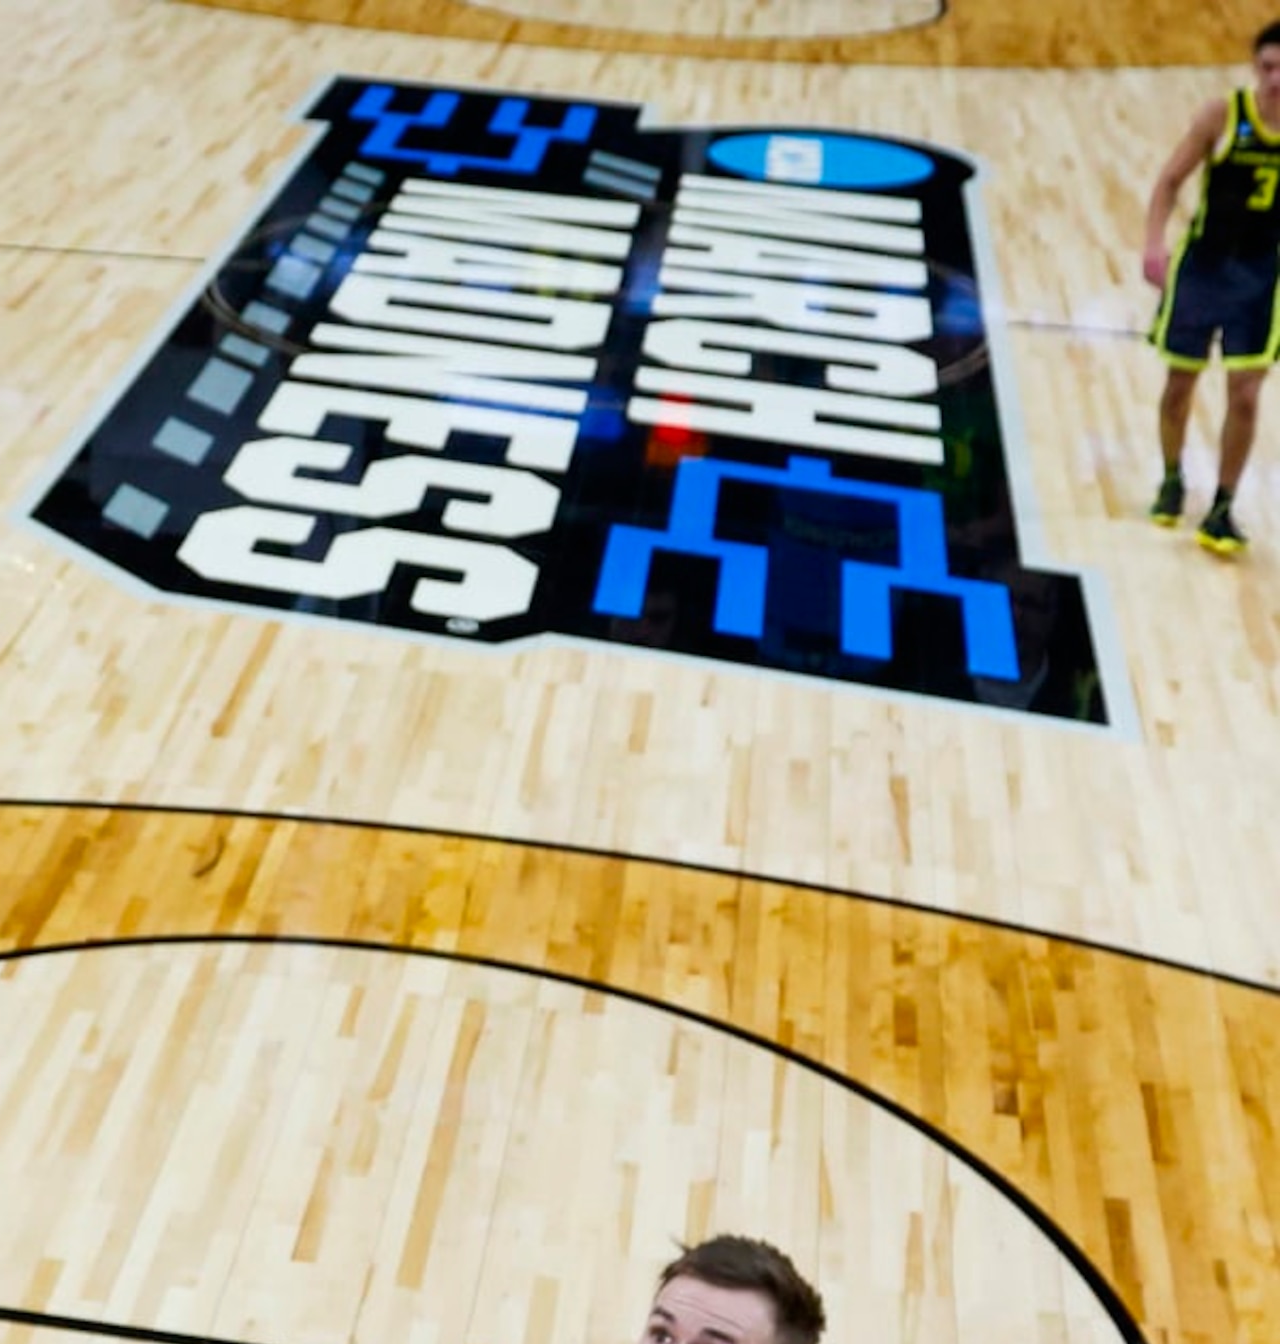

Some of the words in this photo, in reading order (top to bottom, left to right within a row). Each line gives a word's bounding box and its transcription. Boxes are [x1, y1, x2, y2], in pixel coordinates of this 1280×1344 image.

[627, 172, 946, 466] MARCH
[1246, 166, 1278, 211] 3
[176, 177, 642, 622] MADNESS
